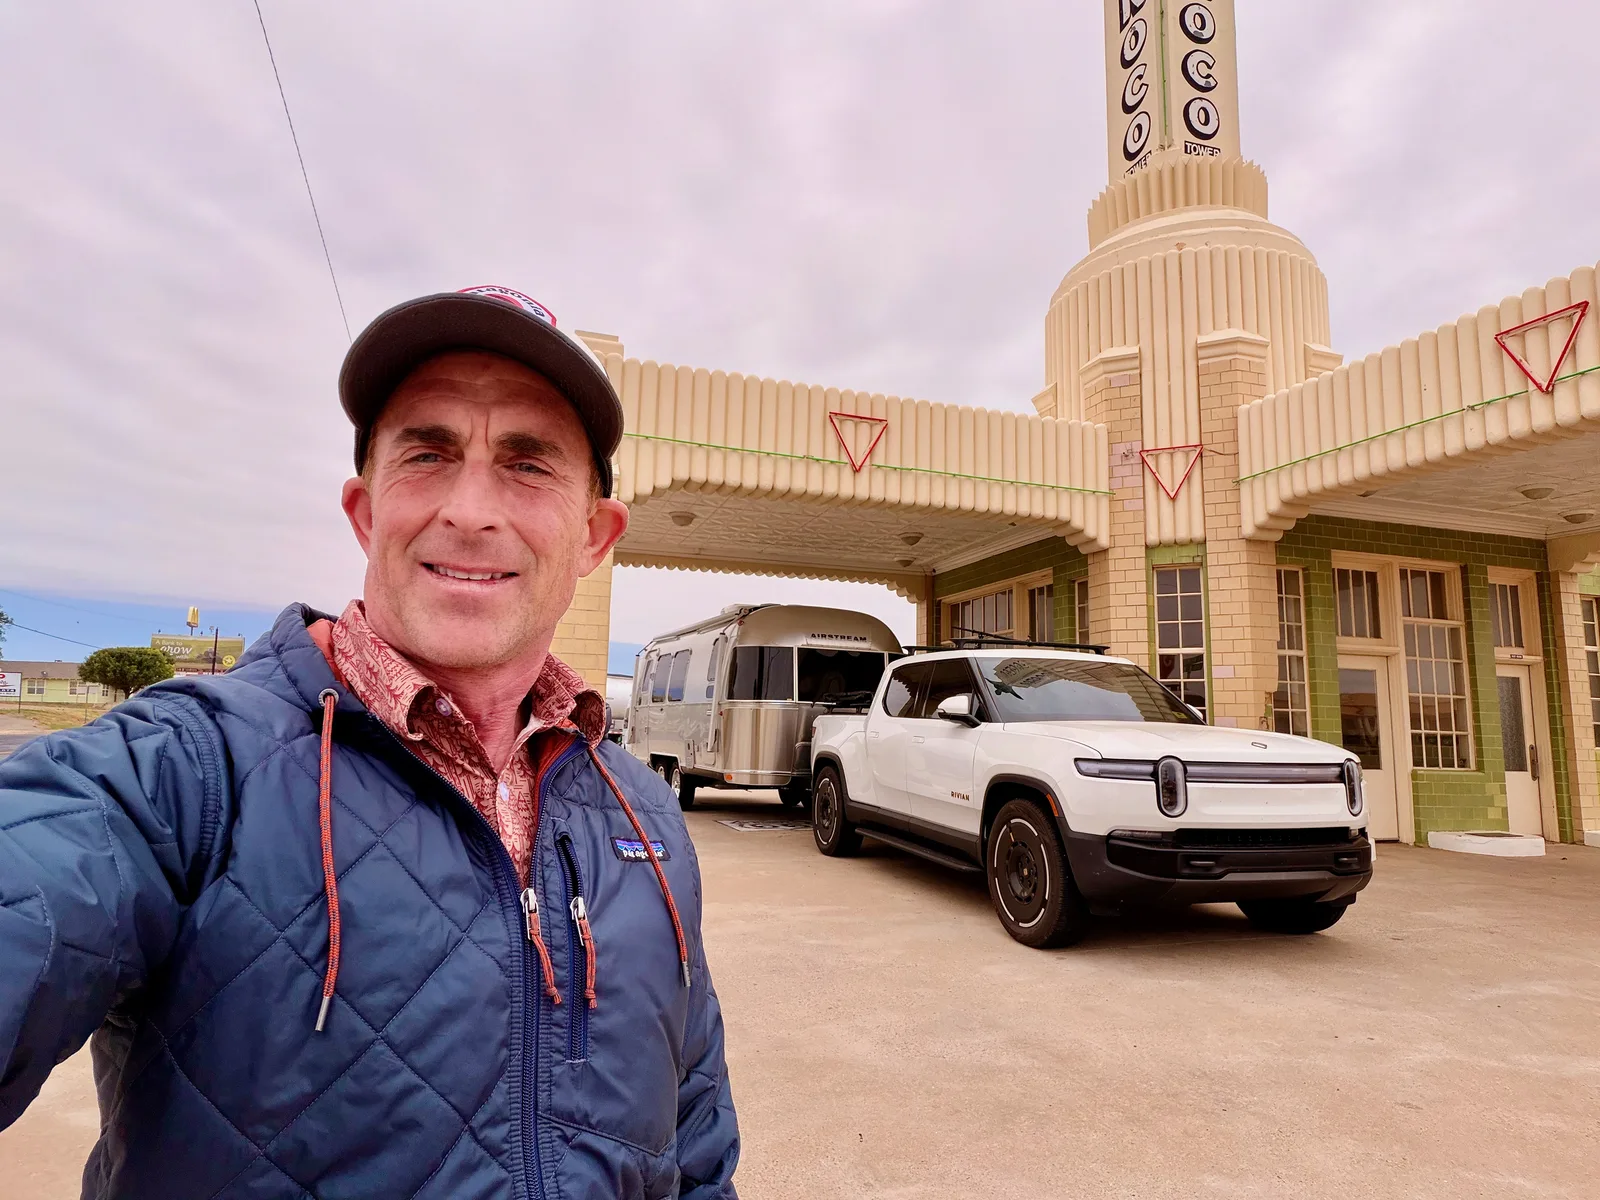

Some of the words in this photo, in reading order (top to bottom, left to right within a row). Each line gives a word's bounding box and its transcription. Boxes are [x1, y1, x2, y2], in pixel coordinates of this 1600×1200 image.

[1185, 142, 1220, 157] TOWER
[810, 633, 867, 642] AIRSTREAM
[951, 791, 970, 801] RIVIAN
